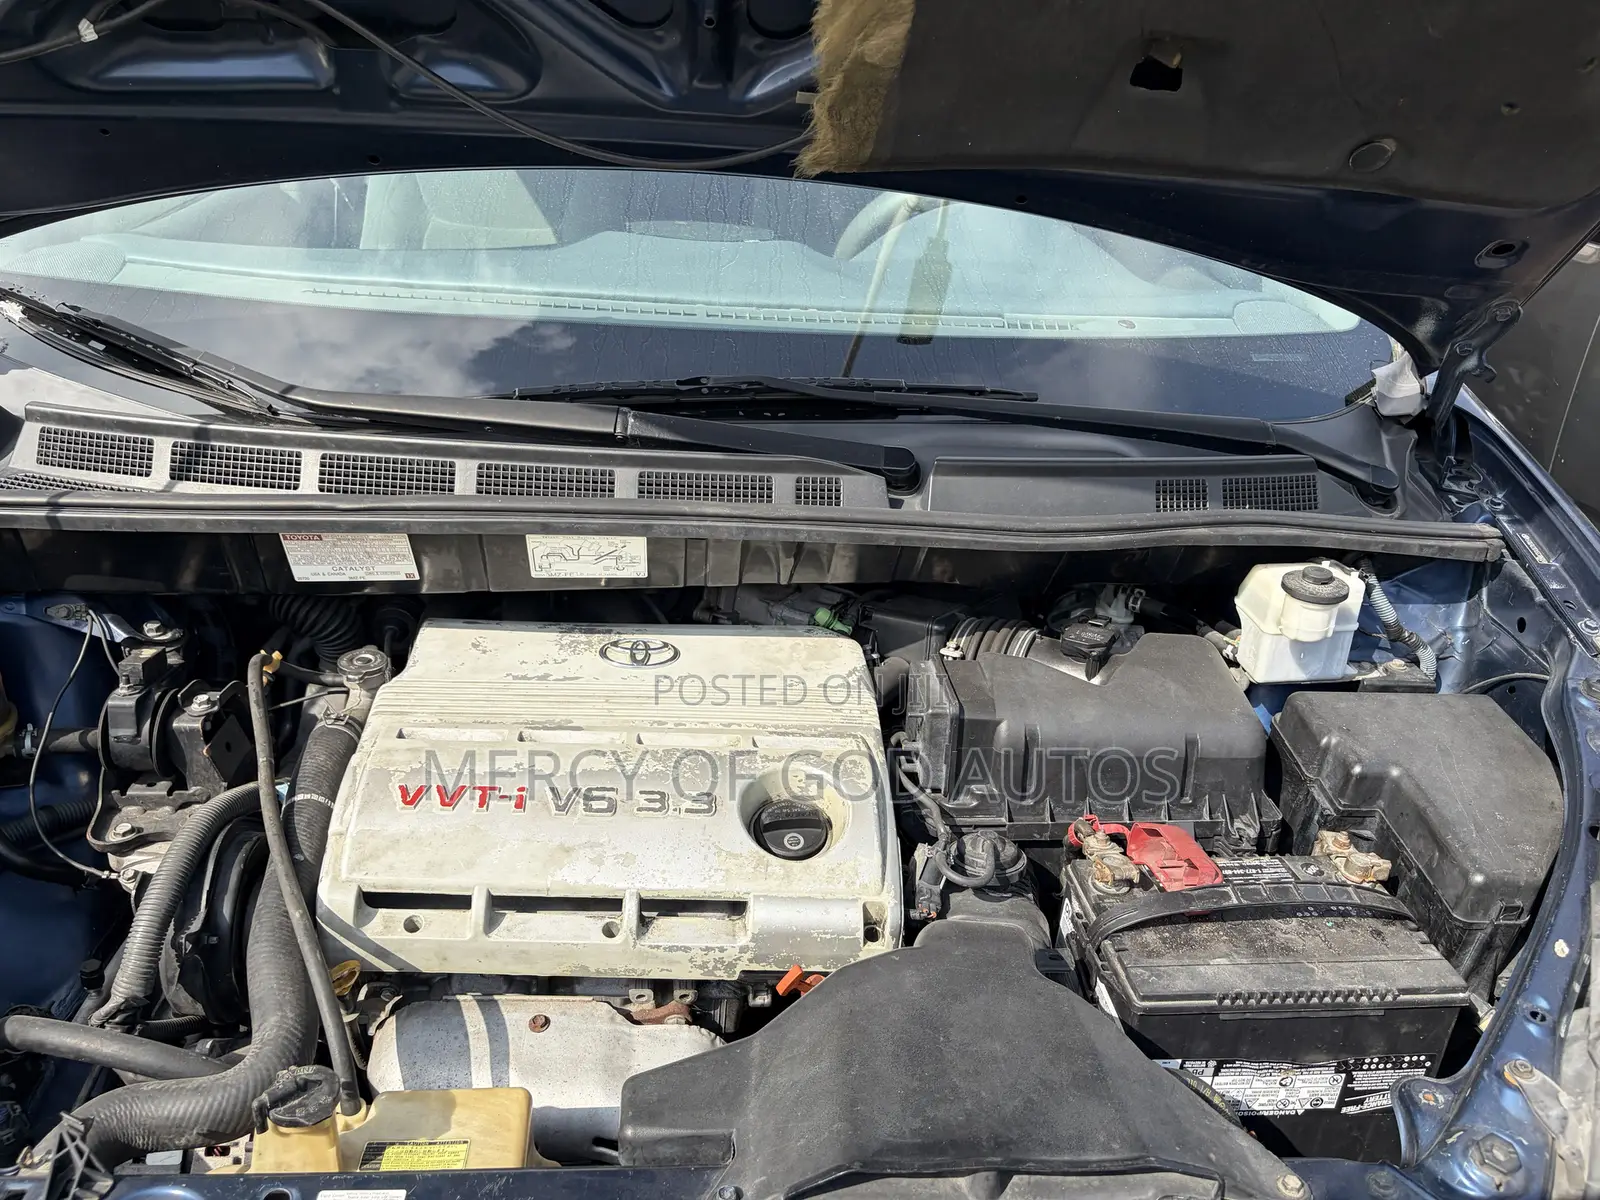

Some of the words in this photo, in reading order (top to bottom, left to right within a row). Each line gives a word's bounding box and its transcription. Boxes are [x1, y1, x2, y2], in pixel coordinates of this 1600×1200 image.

[398, 784, 529, 814] VVT-i
[546, 786, 619, 816] V6
[634, 789, 719, 817] 3.3
[1192, 1068, 1205, 1076] Pb
